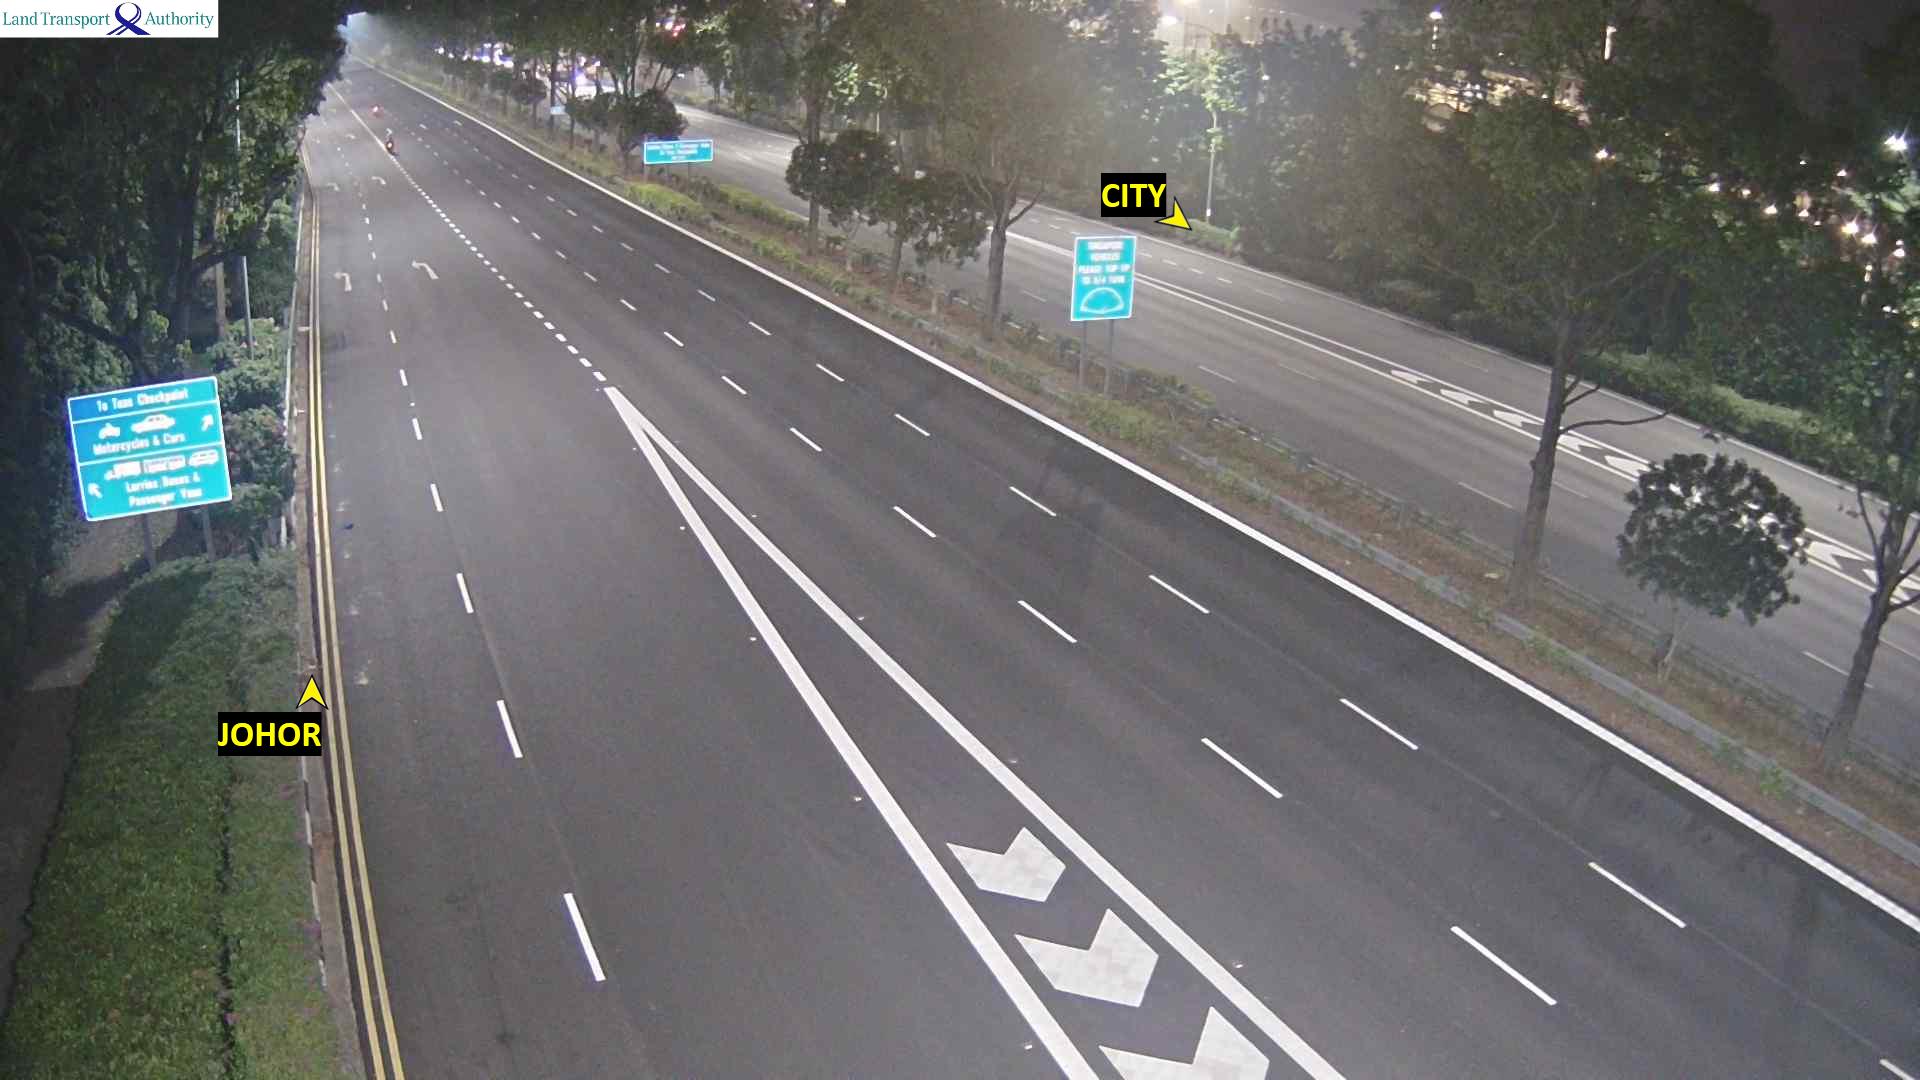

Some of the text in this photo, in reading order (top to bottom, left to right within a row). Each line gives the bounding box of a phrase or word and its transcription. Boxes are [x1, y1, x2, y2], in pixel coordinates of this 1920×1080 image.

[97, 400, 108, 412] To
[137, 388, 188, 405] Checkpoint
[93, 433, 185, 456] Motorcycles & Cars
